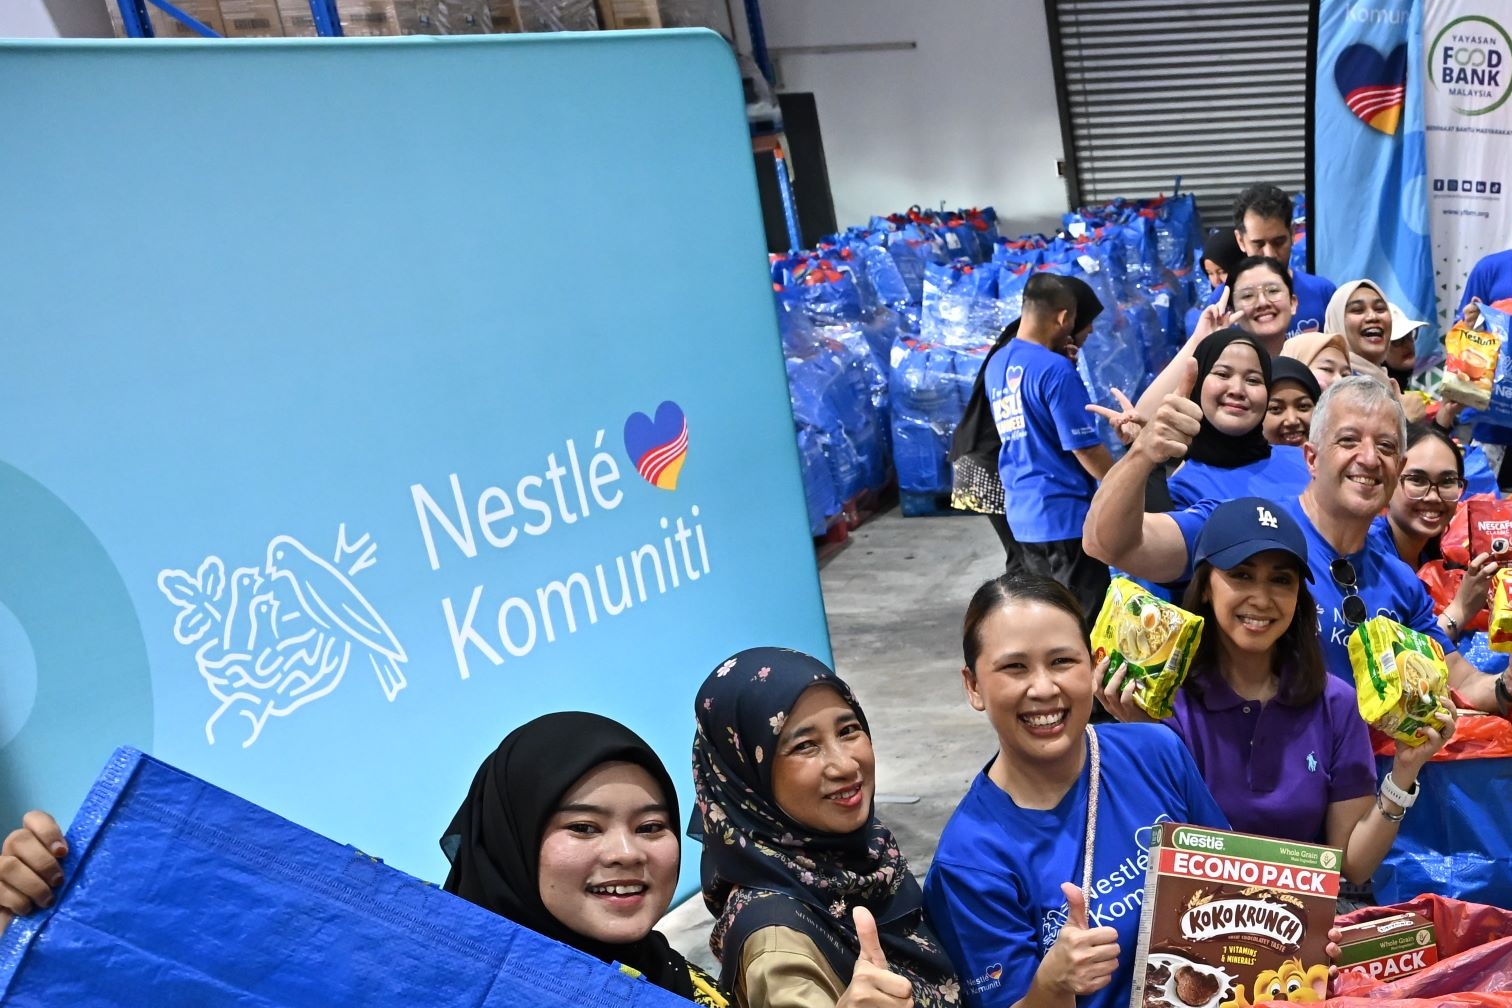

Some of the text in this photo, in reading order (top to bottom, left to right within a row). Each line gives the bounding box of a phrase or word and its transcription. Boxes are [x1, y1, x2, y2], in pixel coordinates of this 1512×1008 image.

[1347, 5, 1409, 24] Komun
[1452, 35, 1496, 45] YAYASAN
[1443, 46, 1502, 68] FOOD
[1442, 67, 1500, 86] BANK
[1449, 88, 1492, 98] MALAYSIA
[409, 430, 624, 571] Nestlé
[1256, 506, 1278, 528] LA
[441, 505, 712, 680] Komuniti
[1279, 847, 1300, 857] Whole
[1300, 850, 1319, 859] Grain
[1173, 852, 1327, 893] ECONO PACK
[1090, 888, 1145, 927] Kom
[1189, 904, 1301, 941] KOKO KRUNCH
[1228, 946, 1258, 958] VITAMINS
[1241, 935, 1271, 947] CHOCOLATEY
[1271, 942, 1286, 953] TASTE
[1380, 940, 1398, 948] Whole
[1398, 936, 1415, 944] Grain
[1369, 950, 1427, 977] PACK
